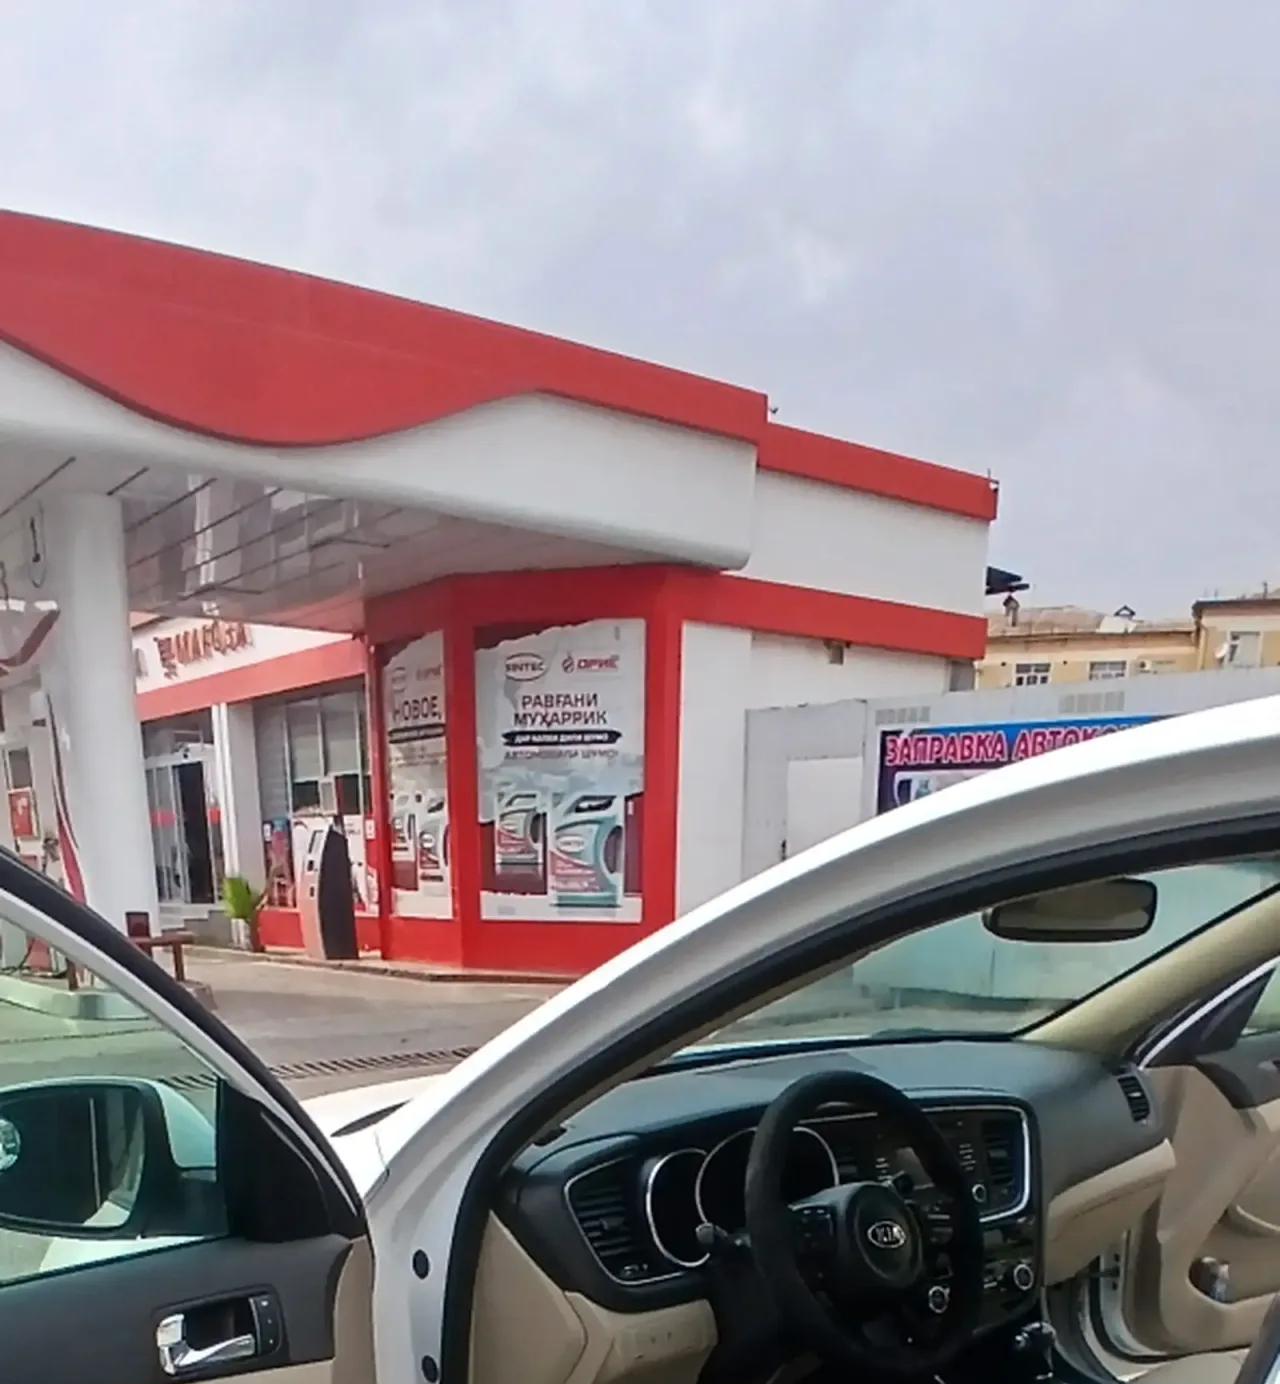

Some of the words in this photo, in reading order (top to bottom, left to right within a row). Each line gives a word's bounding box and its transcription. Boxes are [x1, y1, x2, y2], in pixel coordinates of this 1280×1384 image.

[522, 693, 598, 709] РАВҒАНИ
[514, 711, 607, 728] МУҲАРРИК
[886, 729, 1008, 766] ЗАПРАВКА
[1012, 724, 1128, 760] АВТОК
